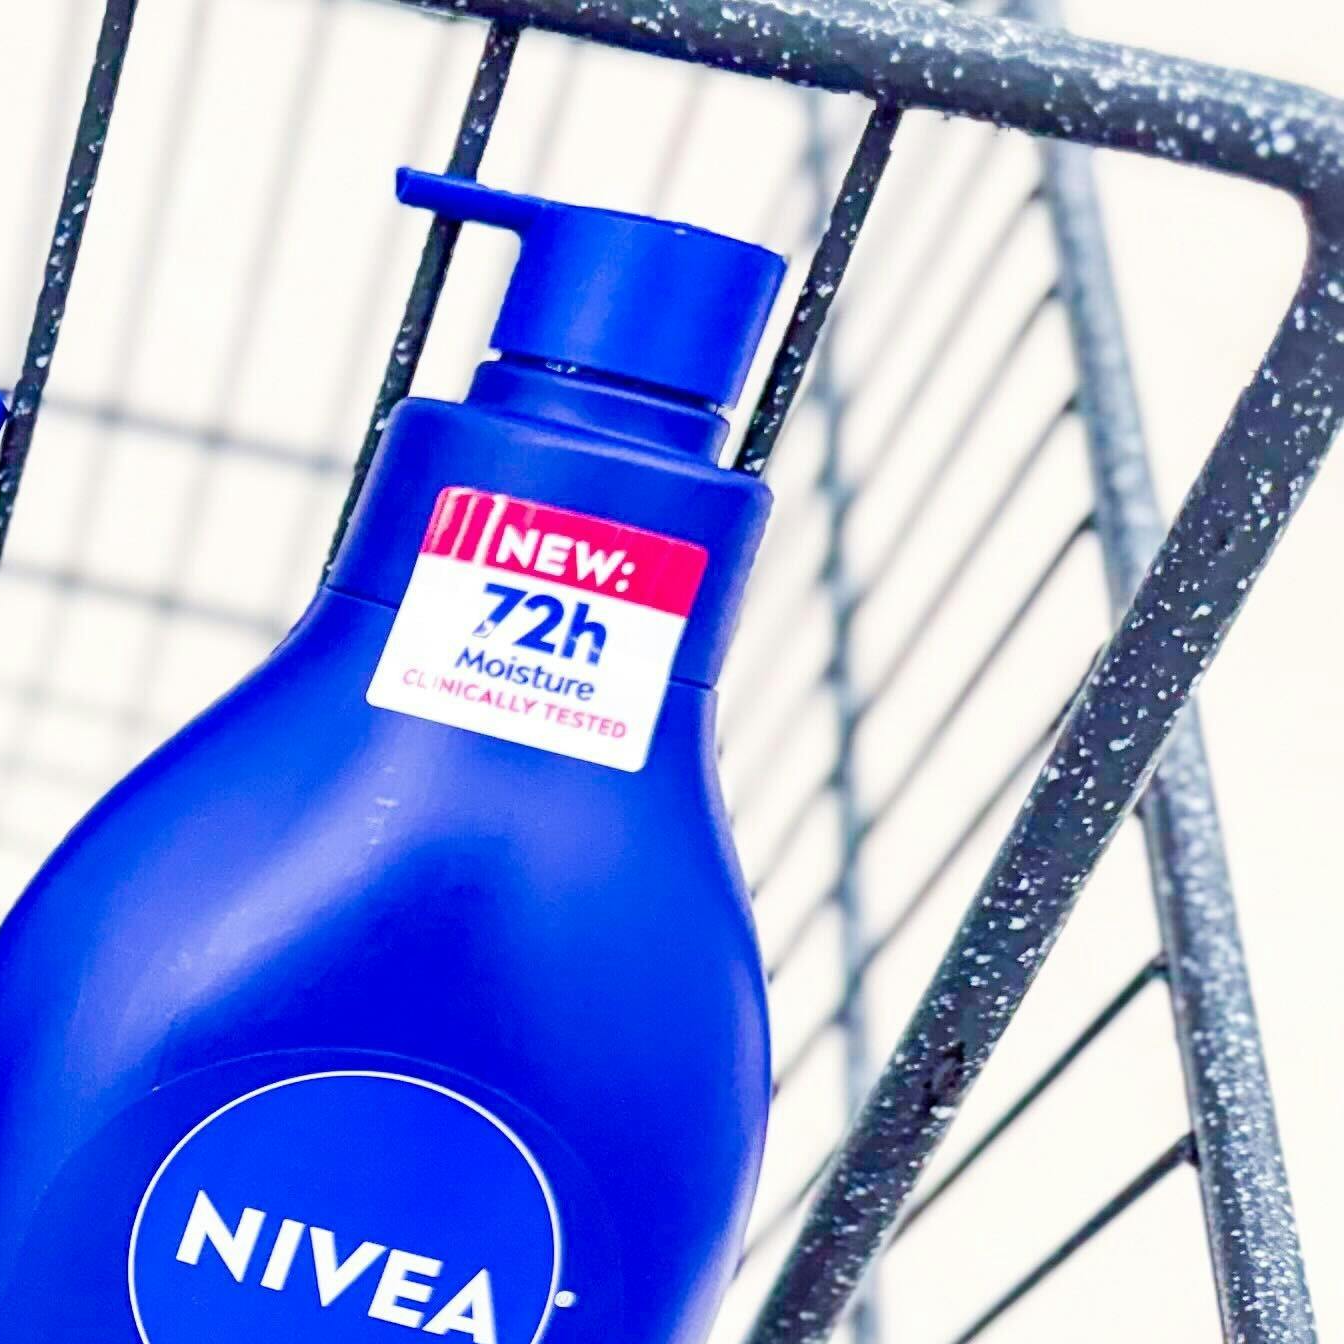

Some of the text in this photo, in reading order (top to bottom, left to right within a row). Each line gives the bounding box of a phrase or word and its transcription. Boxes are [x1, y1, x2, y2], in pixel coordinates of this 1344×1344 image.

[495, 524, 636, 593] NEW:
[472, 581, 608, 666] 72h
[402, 668, 627, 739] CLINICALLY TESTED
[455, 646, 596, 701] Moisture
